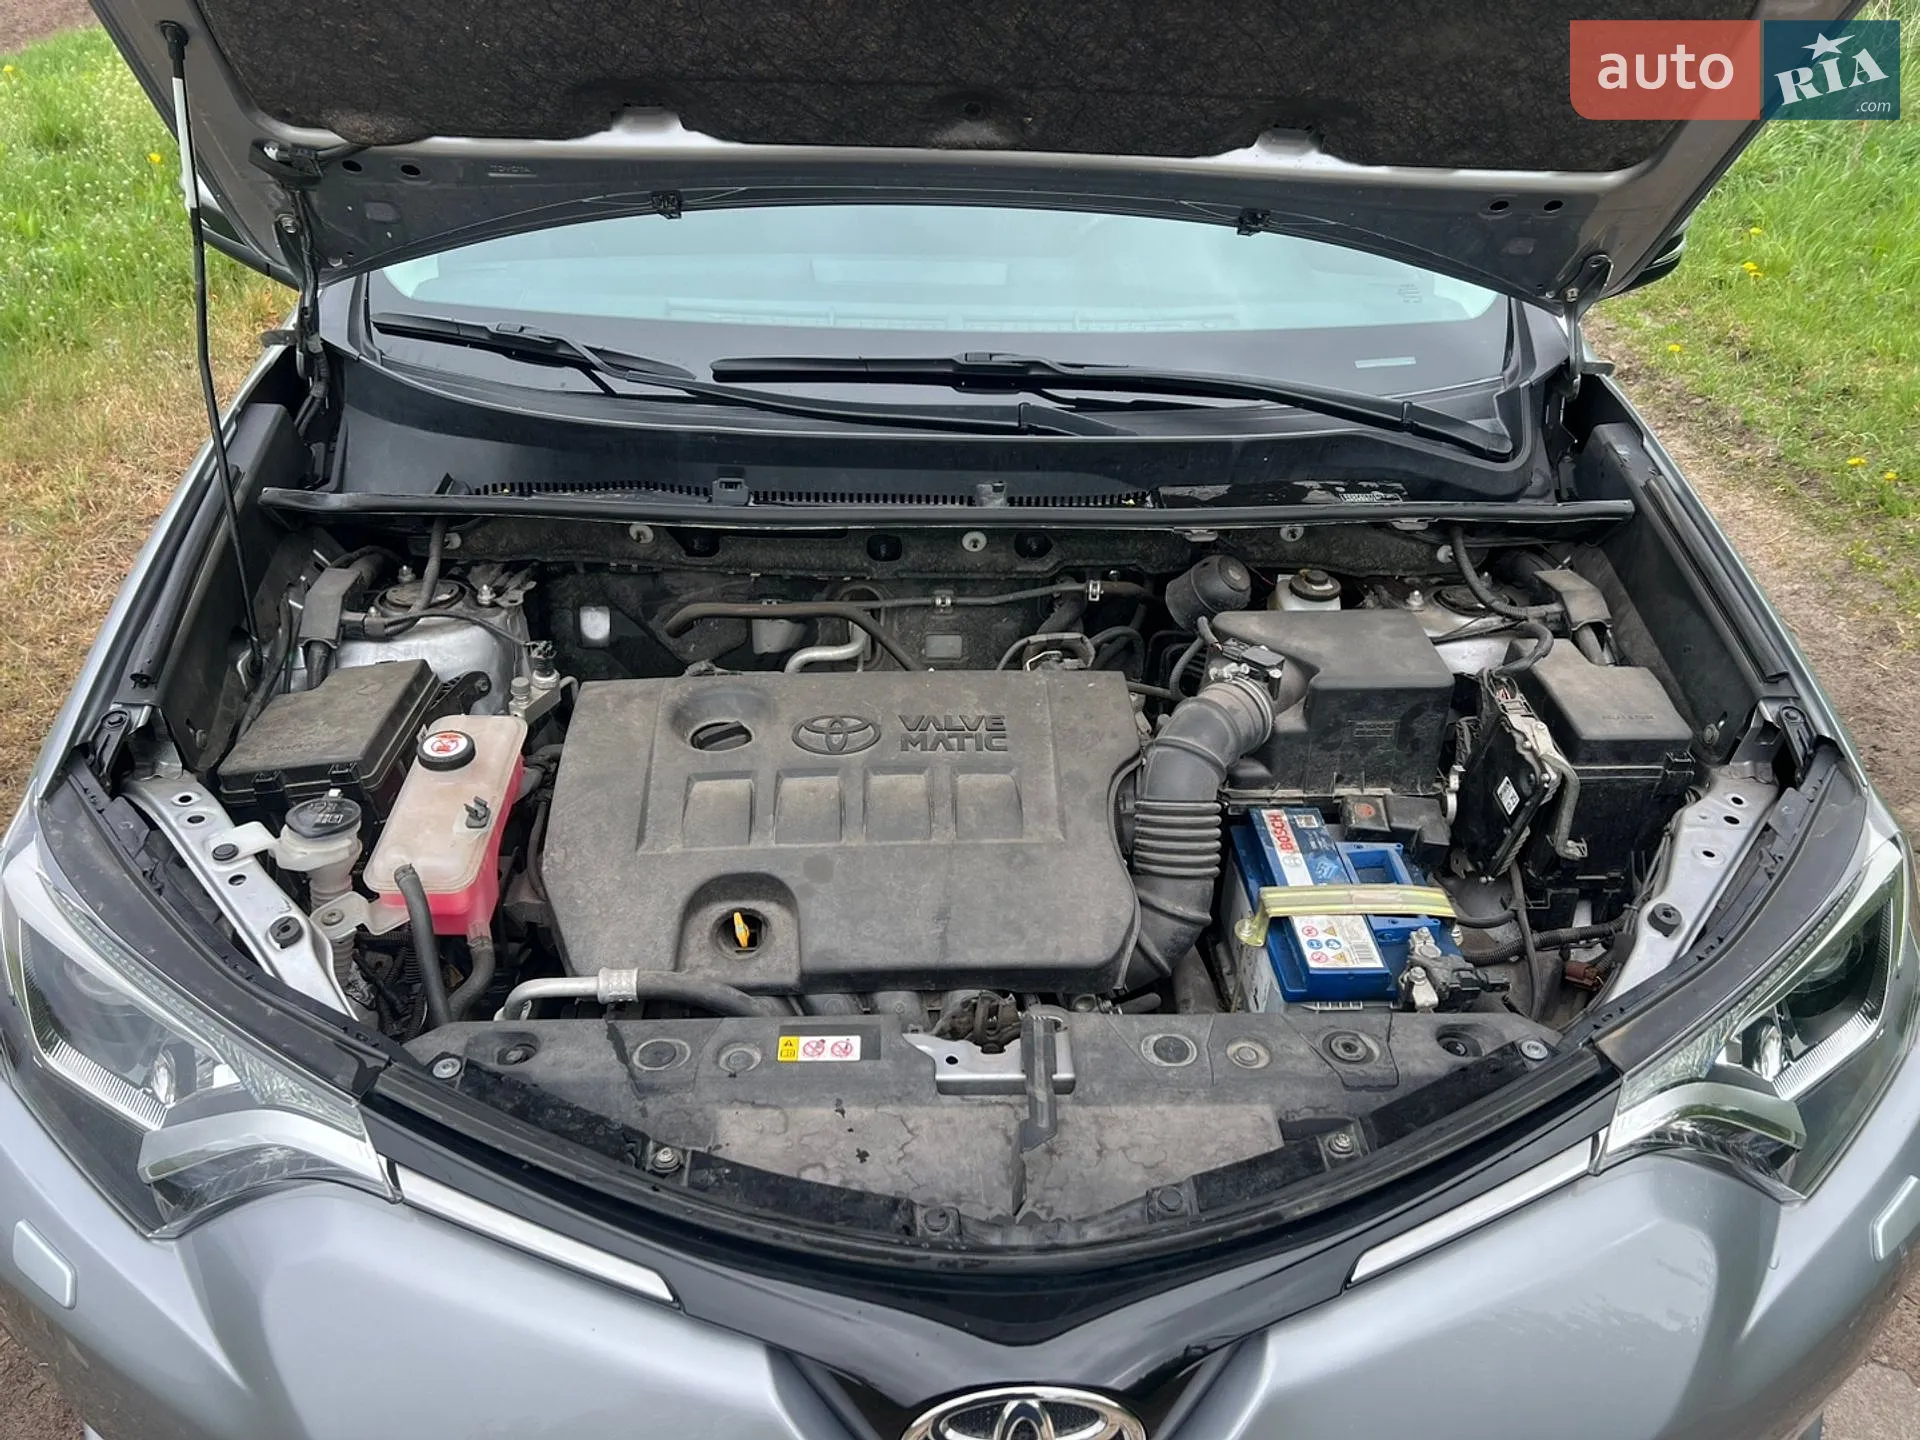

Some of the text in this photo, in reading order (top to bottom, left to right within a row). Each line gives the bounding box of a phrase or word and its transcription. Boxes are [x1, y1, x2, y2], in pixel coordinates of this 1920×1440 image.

[898, 715, 1007, 732] VALVE
[900, 733, 1008, 752] MATIC
[1267, 814, 1294, 852] BOSCH
